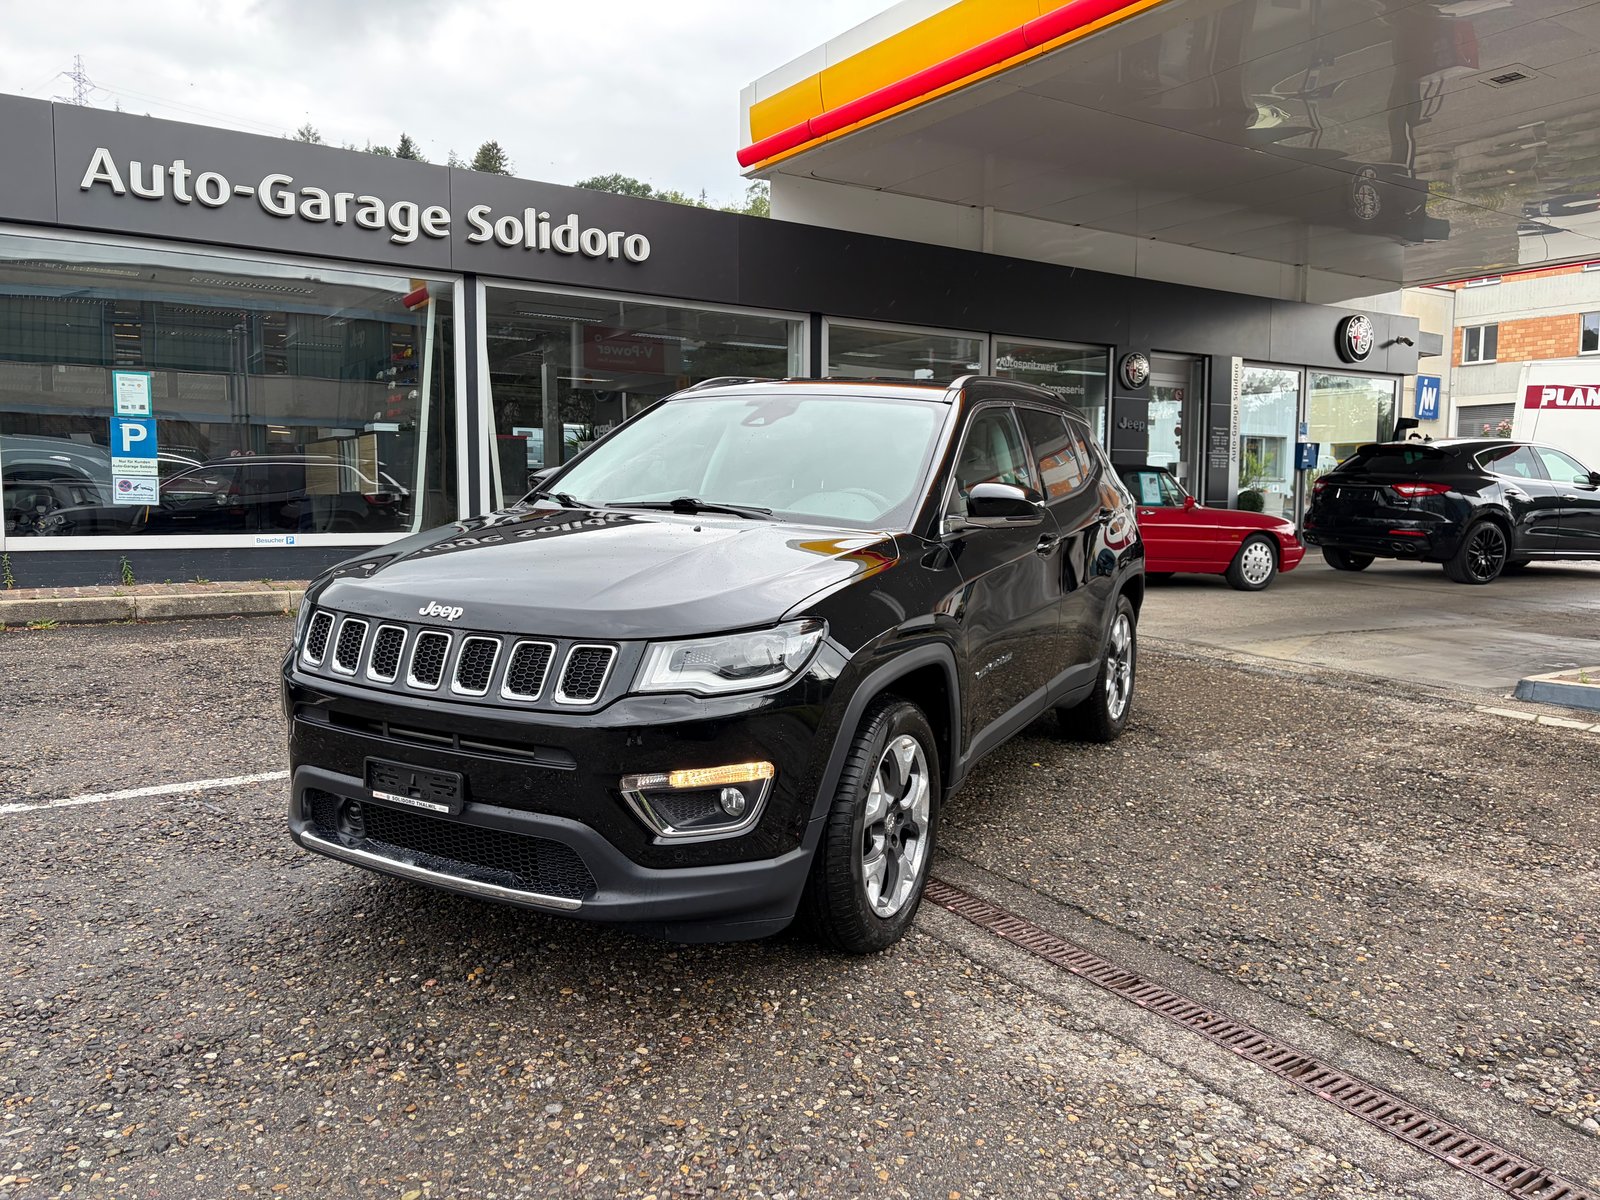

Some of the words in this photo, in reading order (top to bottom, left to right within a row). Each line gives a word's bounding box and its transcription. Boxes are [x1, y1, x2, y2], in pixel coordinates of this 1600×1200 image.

[80, 147, 451, 244] Auto-Garage
[467, 205, 650, 263] Solidoro
[999, 356, 1059, 373] Autospritzwerk
[1119, 417, 1146, 431] Jeep
[119, 423, 148, 452] P
[419, 601, 464, 621] Jeep
